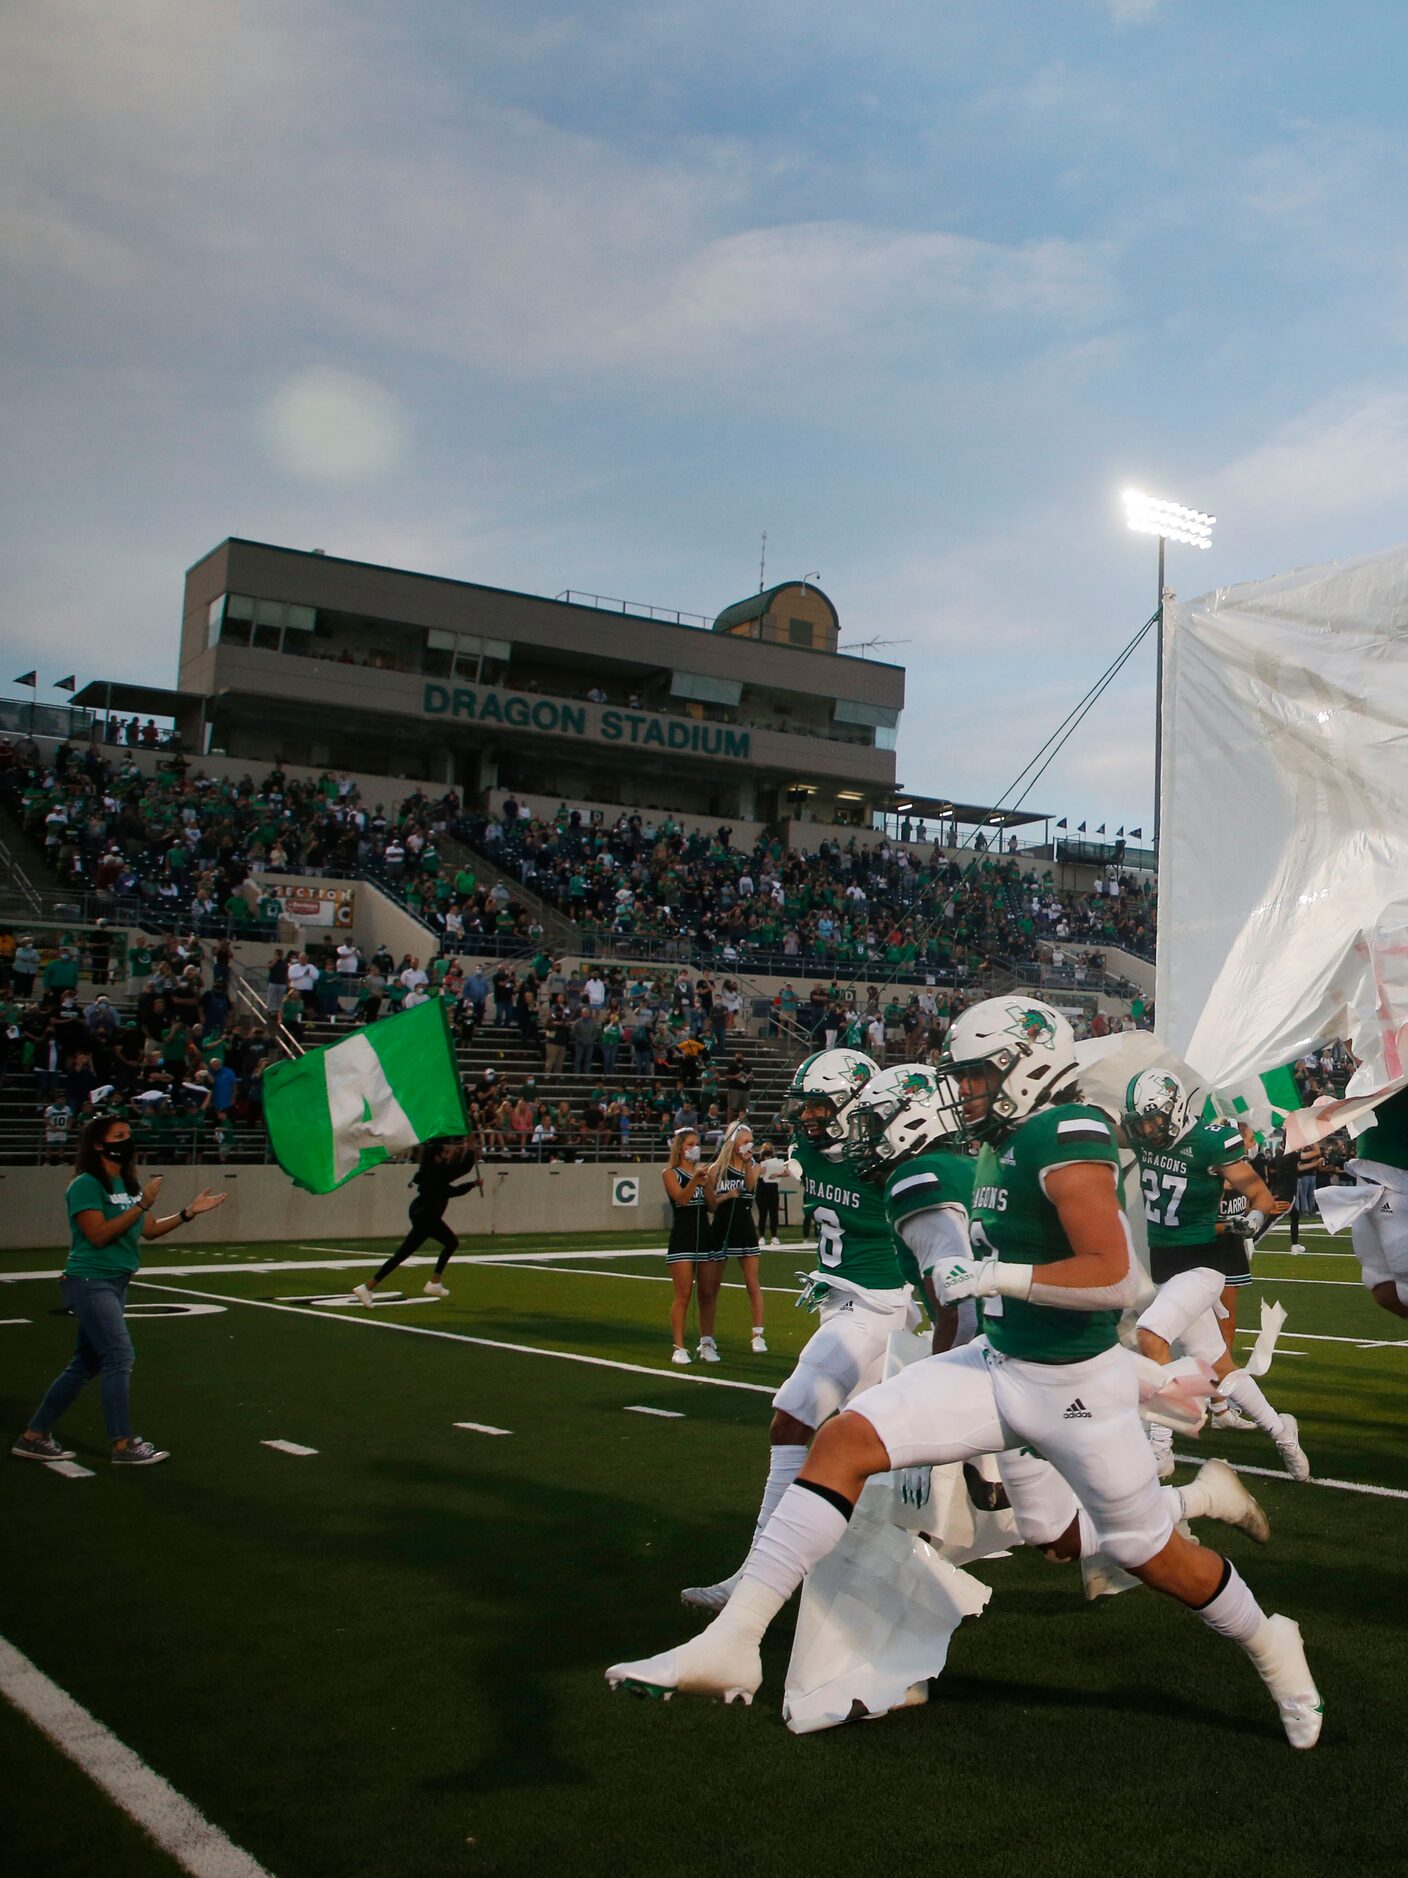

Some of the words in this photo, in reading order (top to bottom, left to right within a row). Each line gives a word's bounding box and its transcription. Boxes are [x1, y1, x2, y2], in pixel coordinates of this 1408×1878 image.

[423, 684, 586, 734] DRAGON
[602, 710, 750, 758] STADIUM
[338, 906, 351, 922] C
[845, 991, 854, 1002] D
[324, 1033, 422, 1185] A
[53, 1117, 66, 1127] 10
[1141, 1147, 1187, 1175] DRAGONS
[615, 1180, 636, 1204] C
[1142, 1168, 1188, 1227] 27
[1220, 1195, 1248, 1215] CARRO
[944, 1273, 975, 1289] adidas
[1063, 1410, 1092, 1419] adidas
